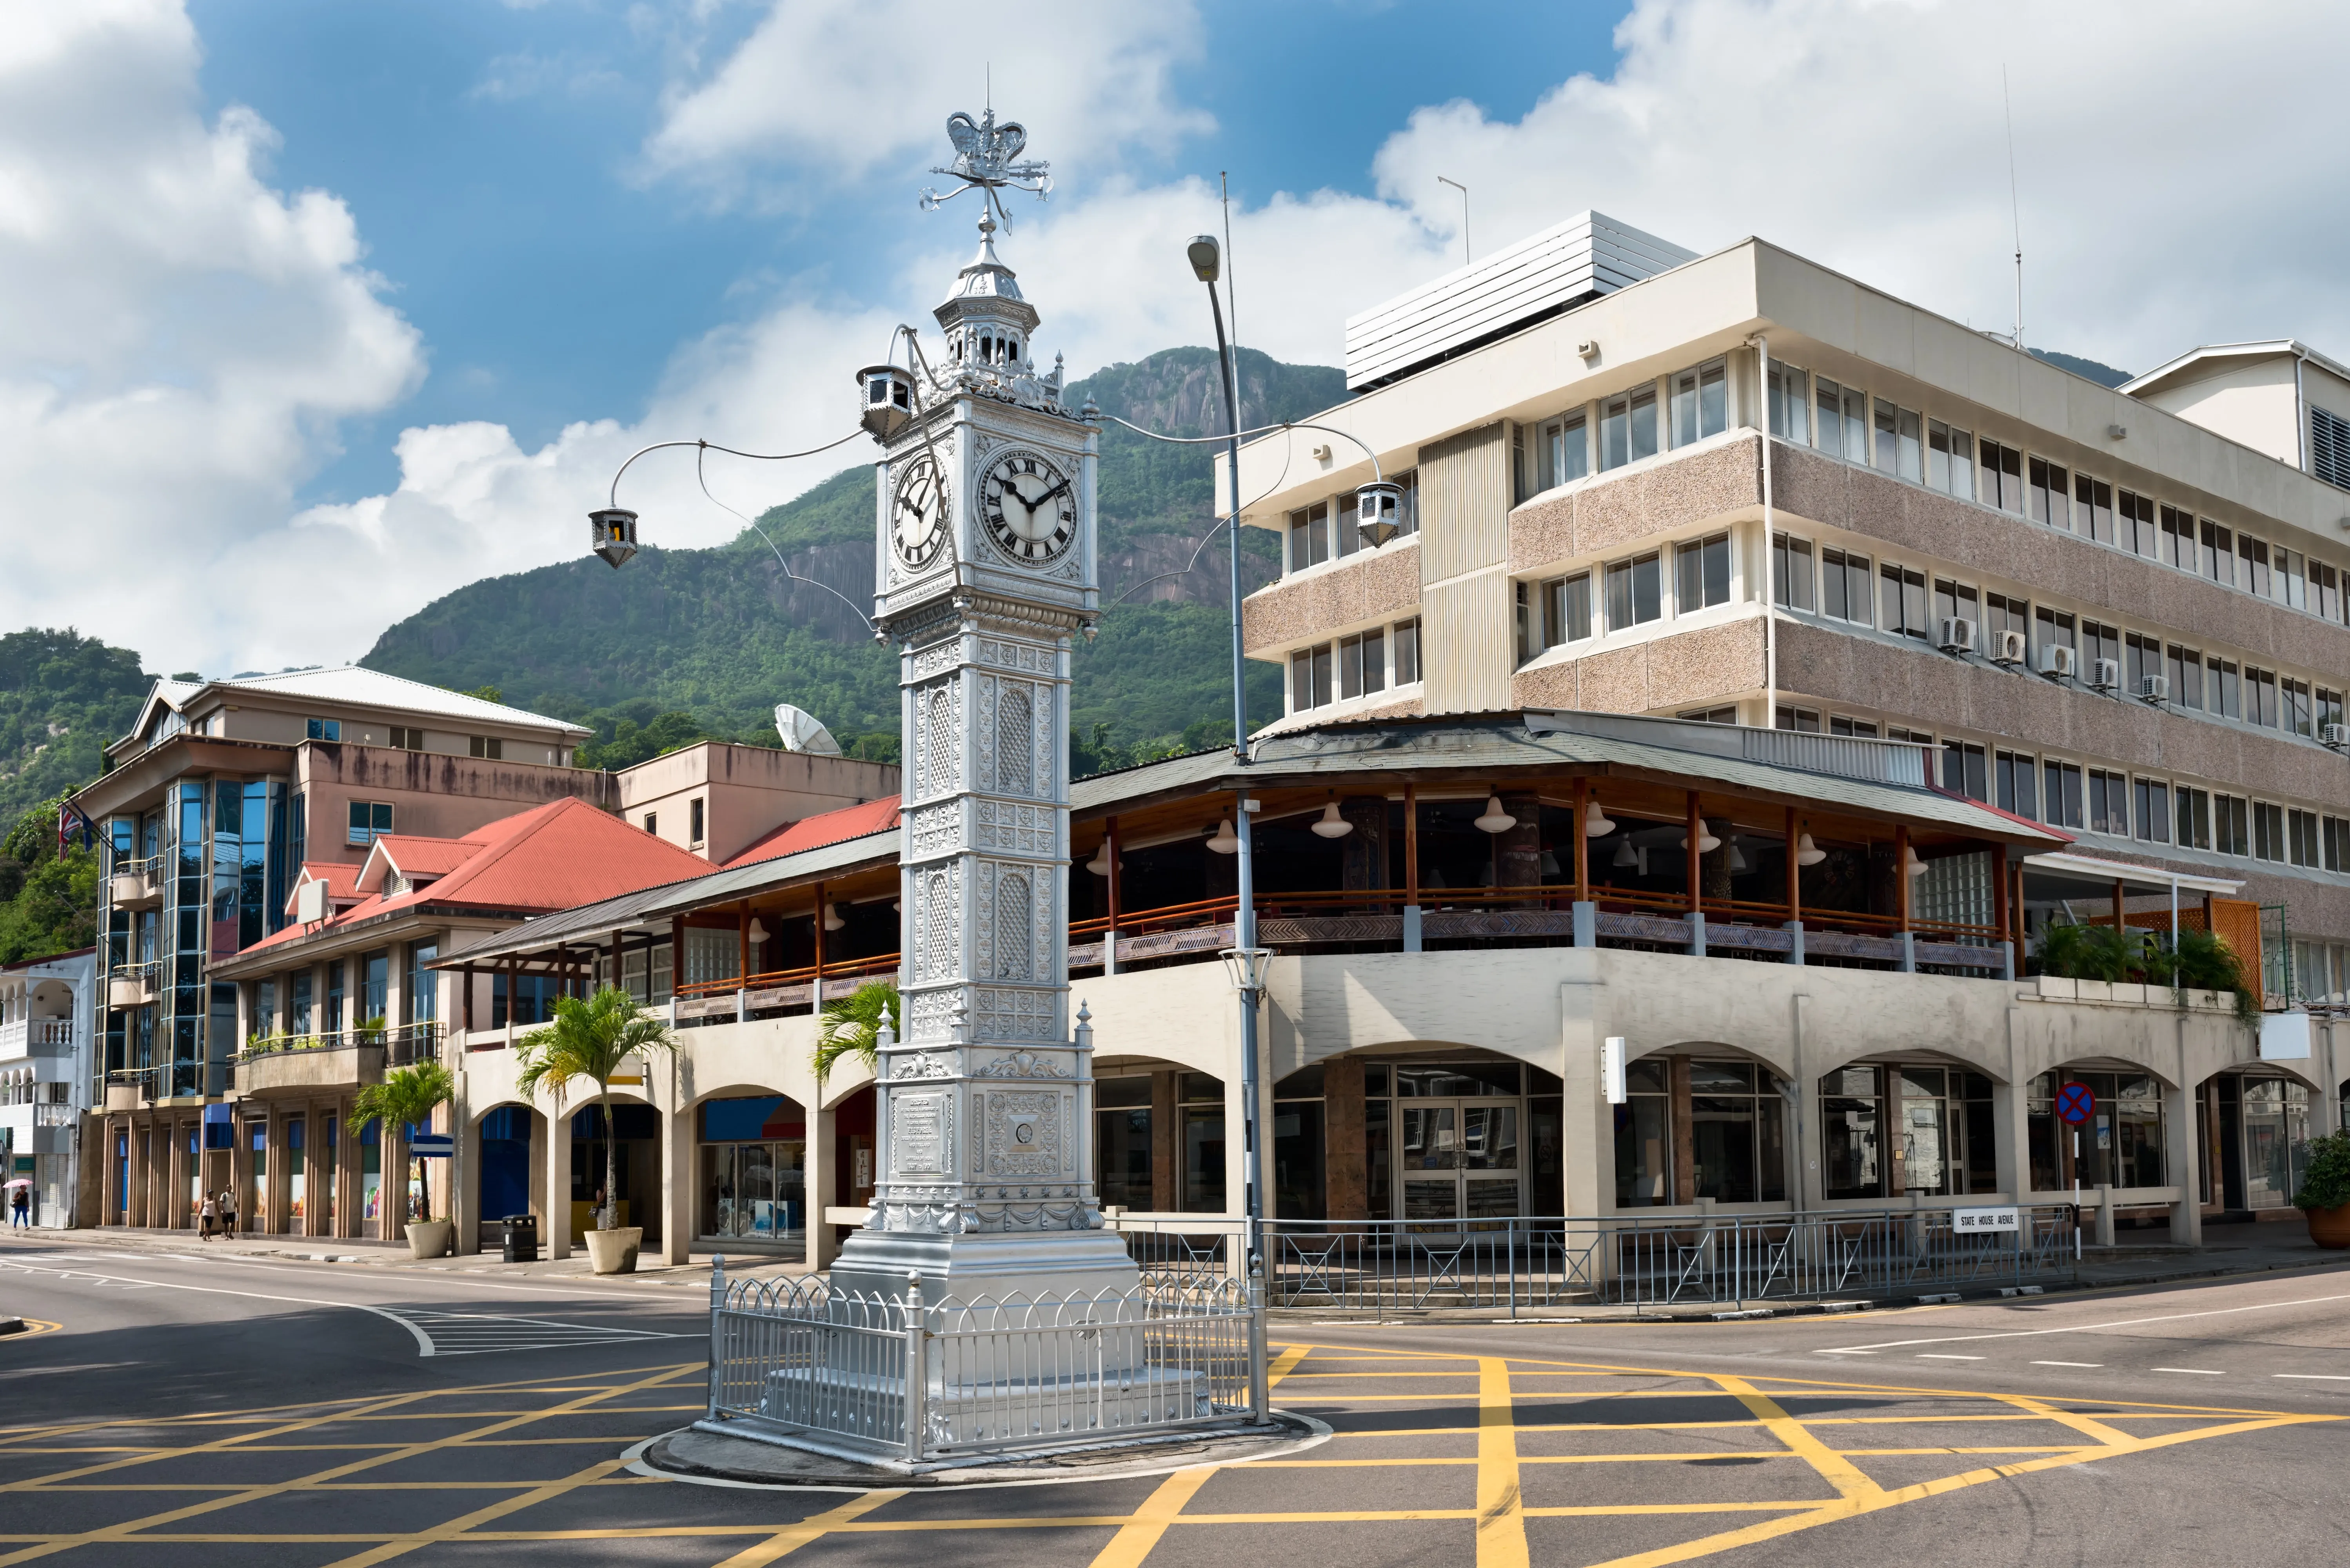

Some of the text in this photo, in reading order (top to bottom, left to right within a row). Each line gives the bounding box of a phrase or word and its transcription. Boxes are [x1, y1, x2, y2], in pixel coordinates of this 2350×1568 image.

[1005, 460, 1019, 477] XI
[1023, 458, 1036, 475] XII
[987, 493, 1001, 507] IX
[1002, 532, 1017, 550] VII
[1044, 541, 1054, 557] V
[1024, 543, 1034, 557] VI
[1961, 1215, 2013, 1226] STATE HOUSE AVENUE
